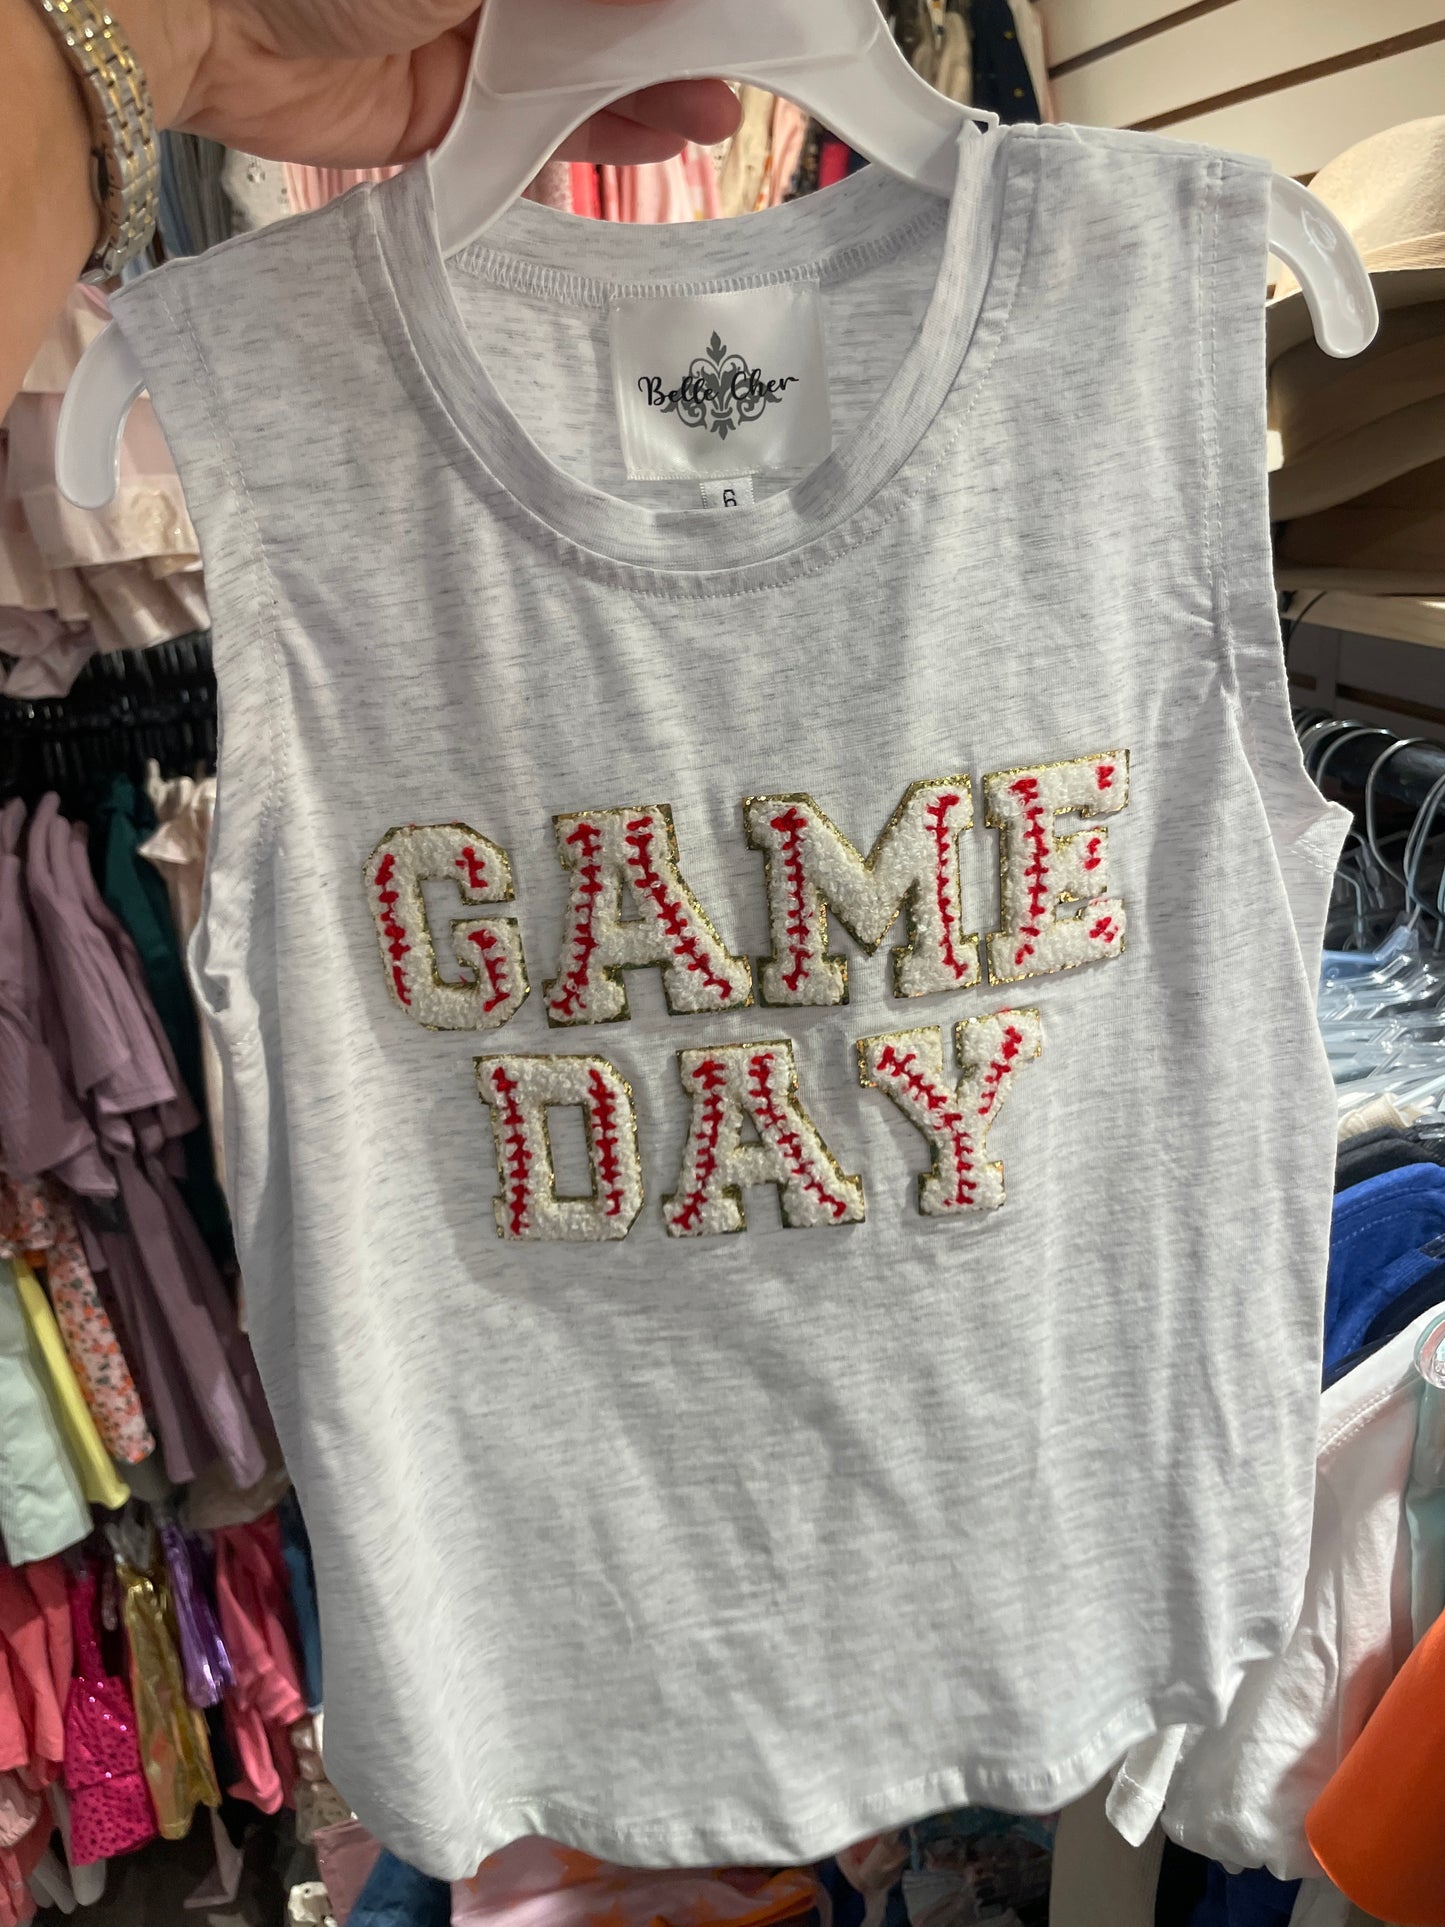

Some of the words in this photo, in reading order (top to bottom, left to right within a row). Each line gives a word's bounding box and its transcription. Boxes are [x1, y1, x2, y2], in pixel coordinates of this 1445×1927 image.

[637, 376, 718, 406] Belle
[731, 368, 799, 400] Cher
[722, 488, 737, 507] 6
[363, 748, 1130, 1032] GAME
[473, 1006, 1043, 1240] DAY
